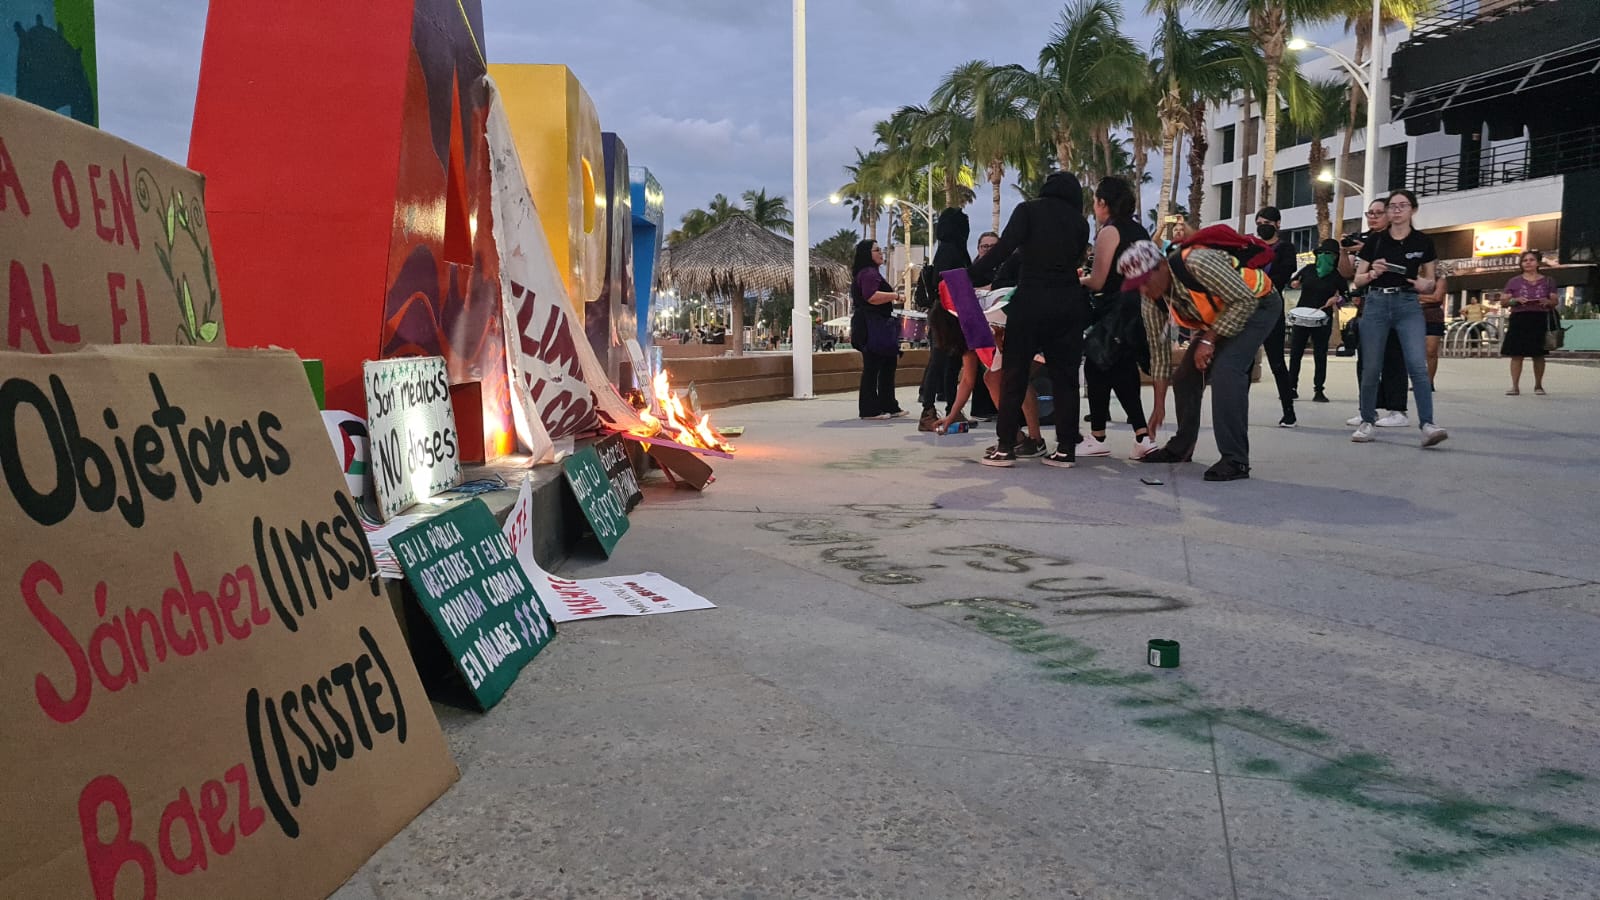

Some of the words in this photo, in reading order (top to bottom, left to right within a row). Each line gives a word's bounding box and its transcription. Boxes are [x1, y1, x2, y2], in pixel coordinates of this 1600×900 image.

[373, 372, 396, 418] Son
[400, 370, 449, 409] médicxs
[0, 372, 291, 528] Objetoras
[379, 427, 403, 498] NO
[407, 426, 456, 474] dioses
[399, 541, 417, 568] EN
[412, 535, 431, 561] LA
[427, 522, 464, 552] PÚBLICA
[421, 550, 474, 598] OBJETORES
[471, 546, 484, 569] Y
[480, 536, 501, 564] EN
[495, 533, 513, 559] LA
[20, 551, 272, 724] Sánchez
[253, 490, 381, 633] (IMSS)
[439, 588, 487, 637] PRIVADA
[482, 566, 524, 606] COBRAN
[461, 648, 486, 689] EN
[474, 622, 521, 672] DÓLARES
[79, 763, 267, 900] Baez
[245, 626, 408, 839] (ISSSTE)
